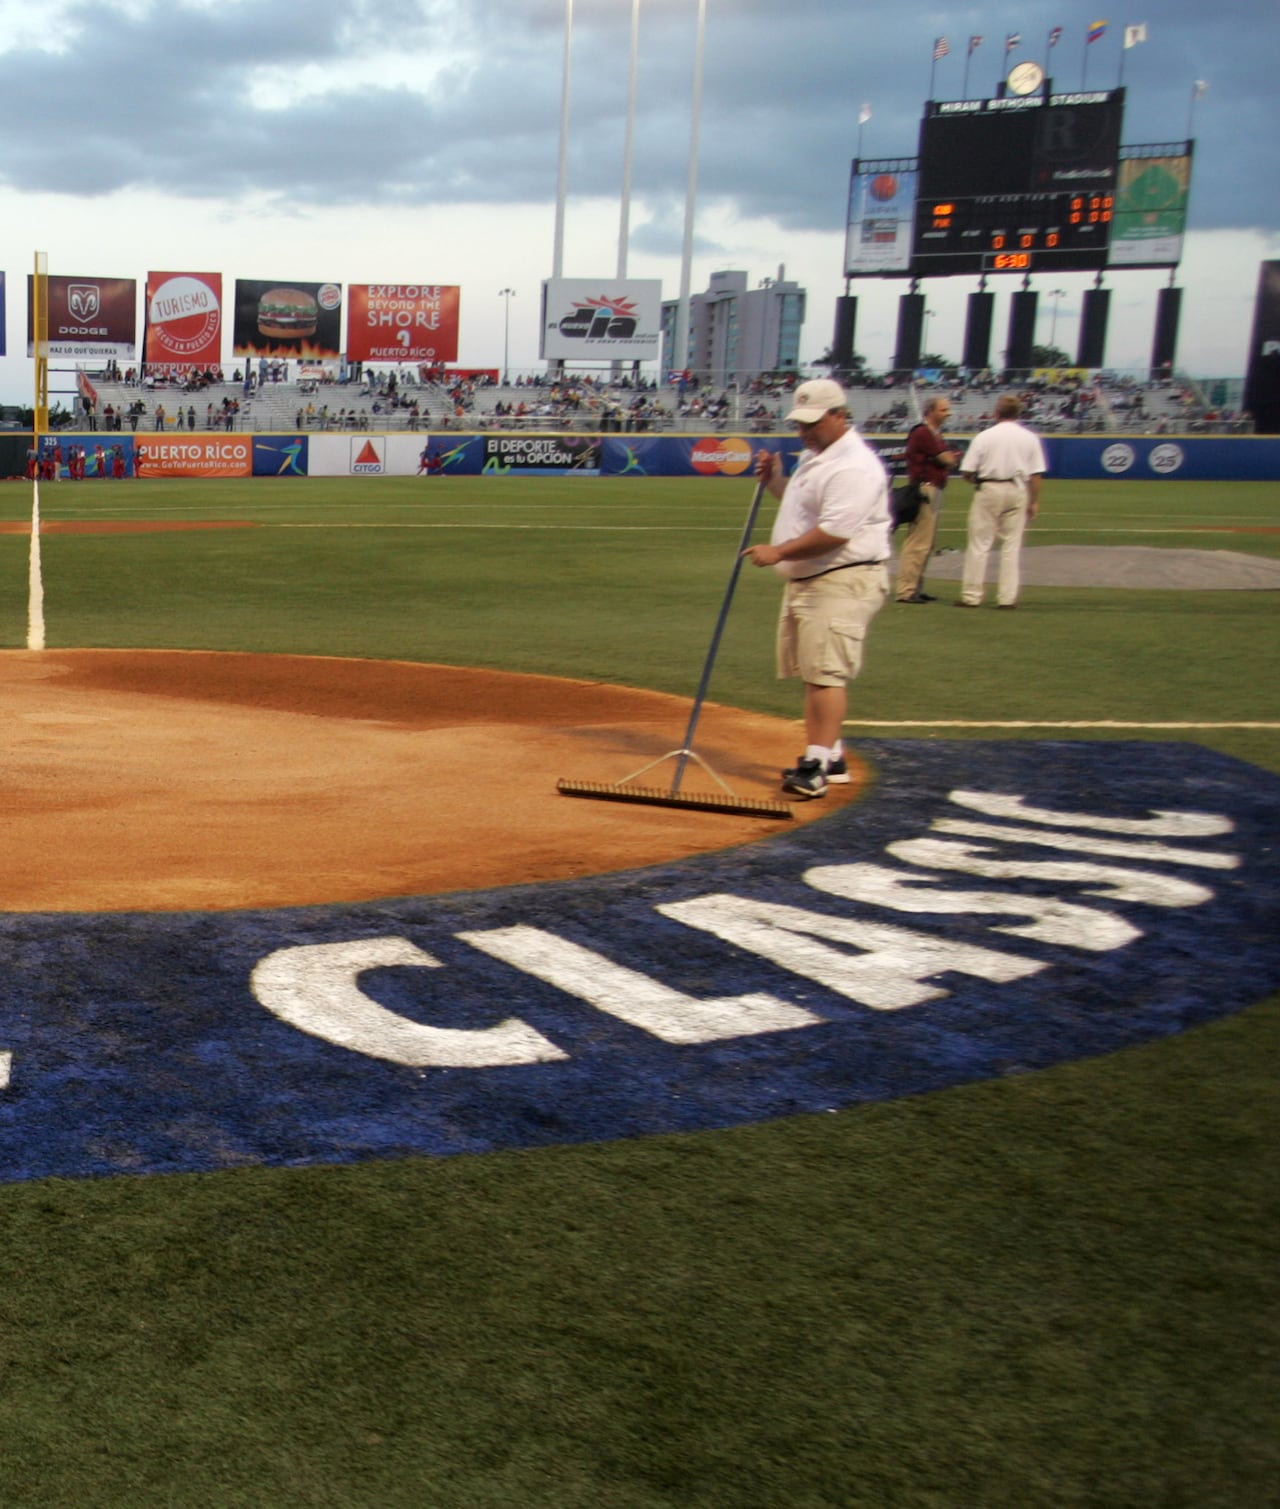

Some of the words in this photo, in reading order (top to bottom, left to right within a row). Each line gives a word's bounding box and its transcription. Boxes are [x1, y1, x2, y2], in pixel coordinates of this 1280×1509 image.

[940, 102, 981, 113] HIRAM
[987, 97, 1043, 110] BITHORN
[1049, 92, 1109, 106] STADIUM
[368, 286, 441, 300] EXPLORE
[155, 291, 208, 318] TURISMO
[368, 300, 415, 310] BEYOND
[421, 300, 440, 311] THE
[368, 311, 441, 330] SHORE
[59, 326, 108, 335] DODGE
[89, 347, 117, 355] QUIERAS
[370, 347, 408, 357] PUERTO
[501, 440, 557, 453] DEPORTE
[140, 446, 202, 460] PUERTO
[504, 455, 515, 463] es
[516, 454, 525, 463] tu
[692, 451, 751, 462] MasterCard
[1108, 455, 1128, 467] 22
[1155, 455, 1177, 467] 25
[353, 464, 381, 472] CITGO
[250, 790, 1241, 1069] CLASSIC
